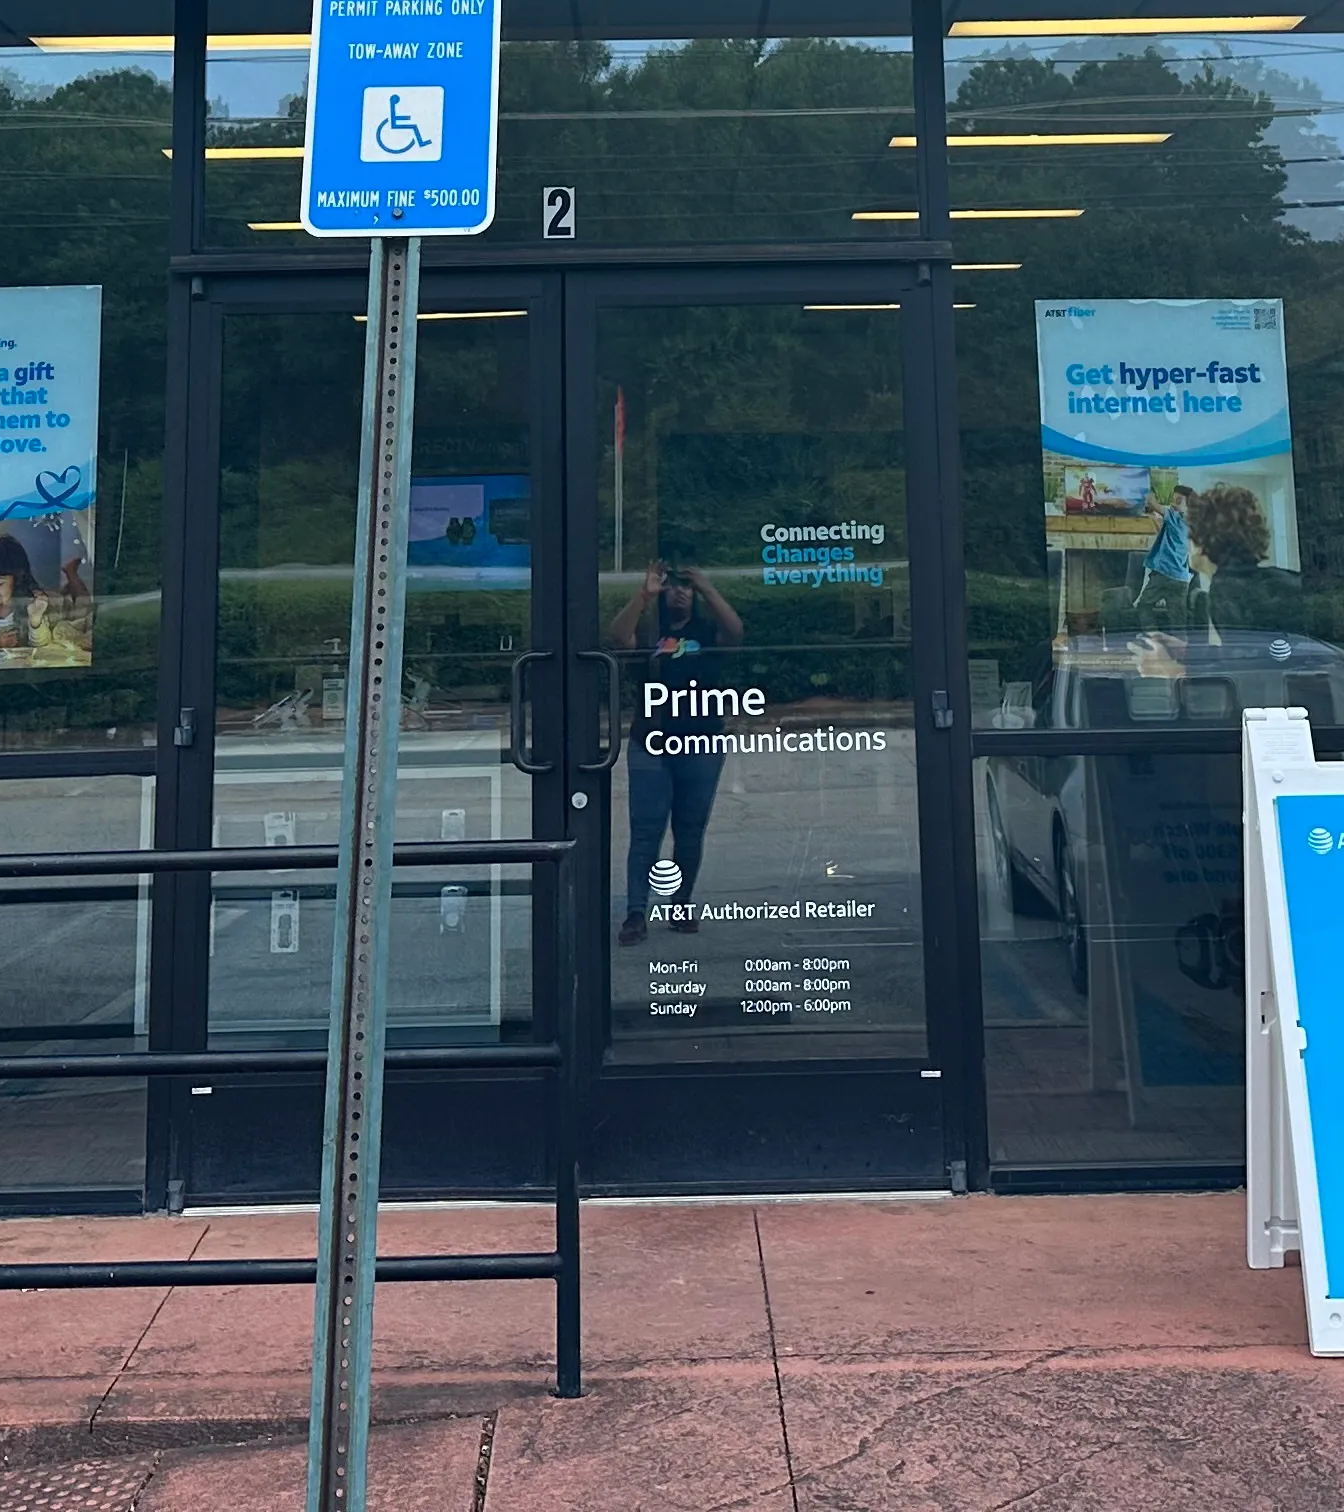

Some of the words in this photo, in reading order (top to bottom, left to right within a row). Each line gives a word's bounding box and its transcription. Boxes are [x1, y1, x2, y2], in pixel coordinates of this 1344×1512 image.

[329, 0, 378, 17] PERMIT
[385, 0, 443, 16] PARKING
[451, 0, 486, 15] ONLY
[348, 43, 419, 60] TOW-AWAY
[427, 42, 464, 59] ZONE
[317, 191, 380, 208] MAXIMUM
[387, 190, 416, 207] FINE
[424, 189, 480, 207] $500.00
[547, 188, 571, 236] 2
[1044, 309, 1066, 318] AT&T
[14, 361, 54, 386] gift
[1065, 364, 1113, 385] Get
[1120, 361, 1261, 390] hyper-fast
[0, 386, 48, 405] that
[1068, 391, 1176, 414] internet
[1184, 390, 1242, 413] here
[46, 411, 70, 428] to
[760, 520, 885, 545] Connecting
[761, 544, 854, 566] Changes
[763, 564, 884, 588] Everything
[644, 680, 766, 718] Prime
[645, 726, 887, 755] Communications
[649, 903, 697, 922] AT&T
[700, 901, 800, 921] Authorized
[806, 900, 875, 918] Retailer
[649, 960, 698, 974] Mon-Fri
[802, 958, 850, 974] 8:00pm
[649, 981, 707, 997] Saturday
[803, 978, 851, 994] 8:00pm
[650, 1002, 697, 1017] Sunday
[740, 1000, 793, 1015] 12:00pm
[804, 999, 851, 1015] 6:00pm
